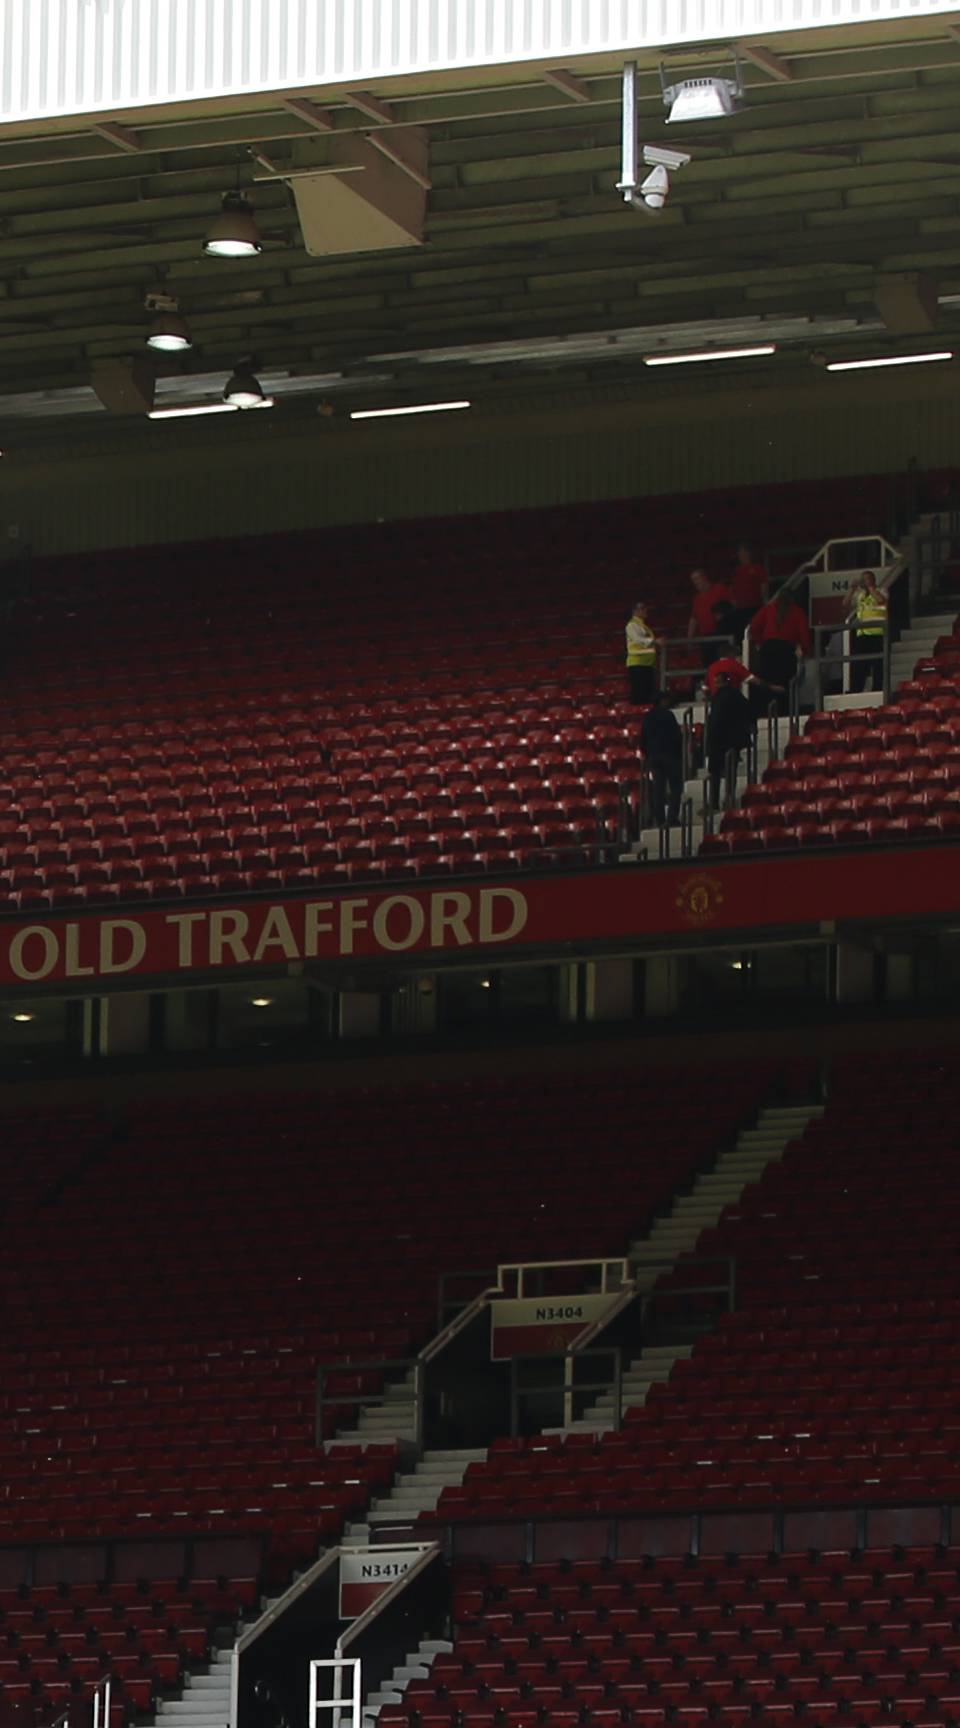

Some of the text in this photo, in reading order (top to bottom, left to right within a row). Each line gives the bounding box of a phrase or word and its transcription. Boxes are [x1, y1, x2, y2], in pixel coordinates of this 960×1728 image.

[9, 919, 147, 981] OLD
[166, 888, 529, 967] TRAFFORD
[536, 1307, 583, 1320] N3404
